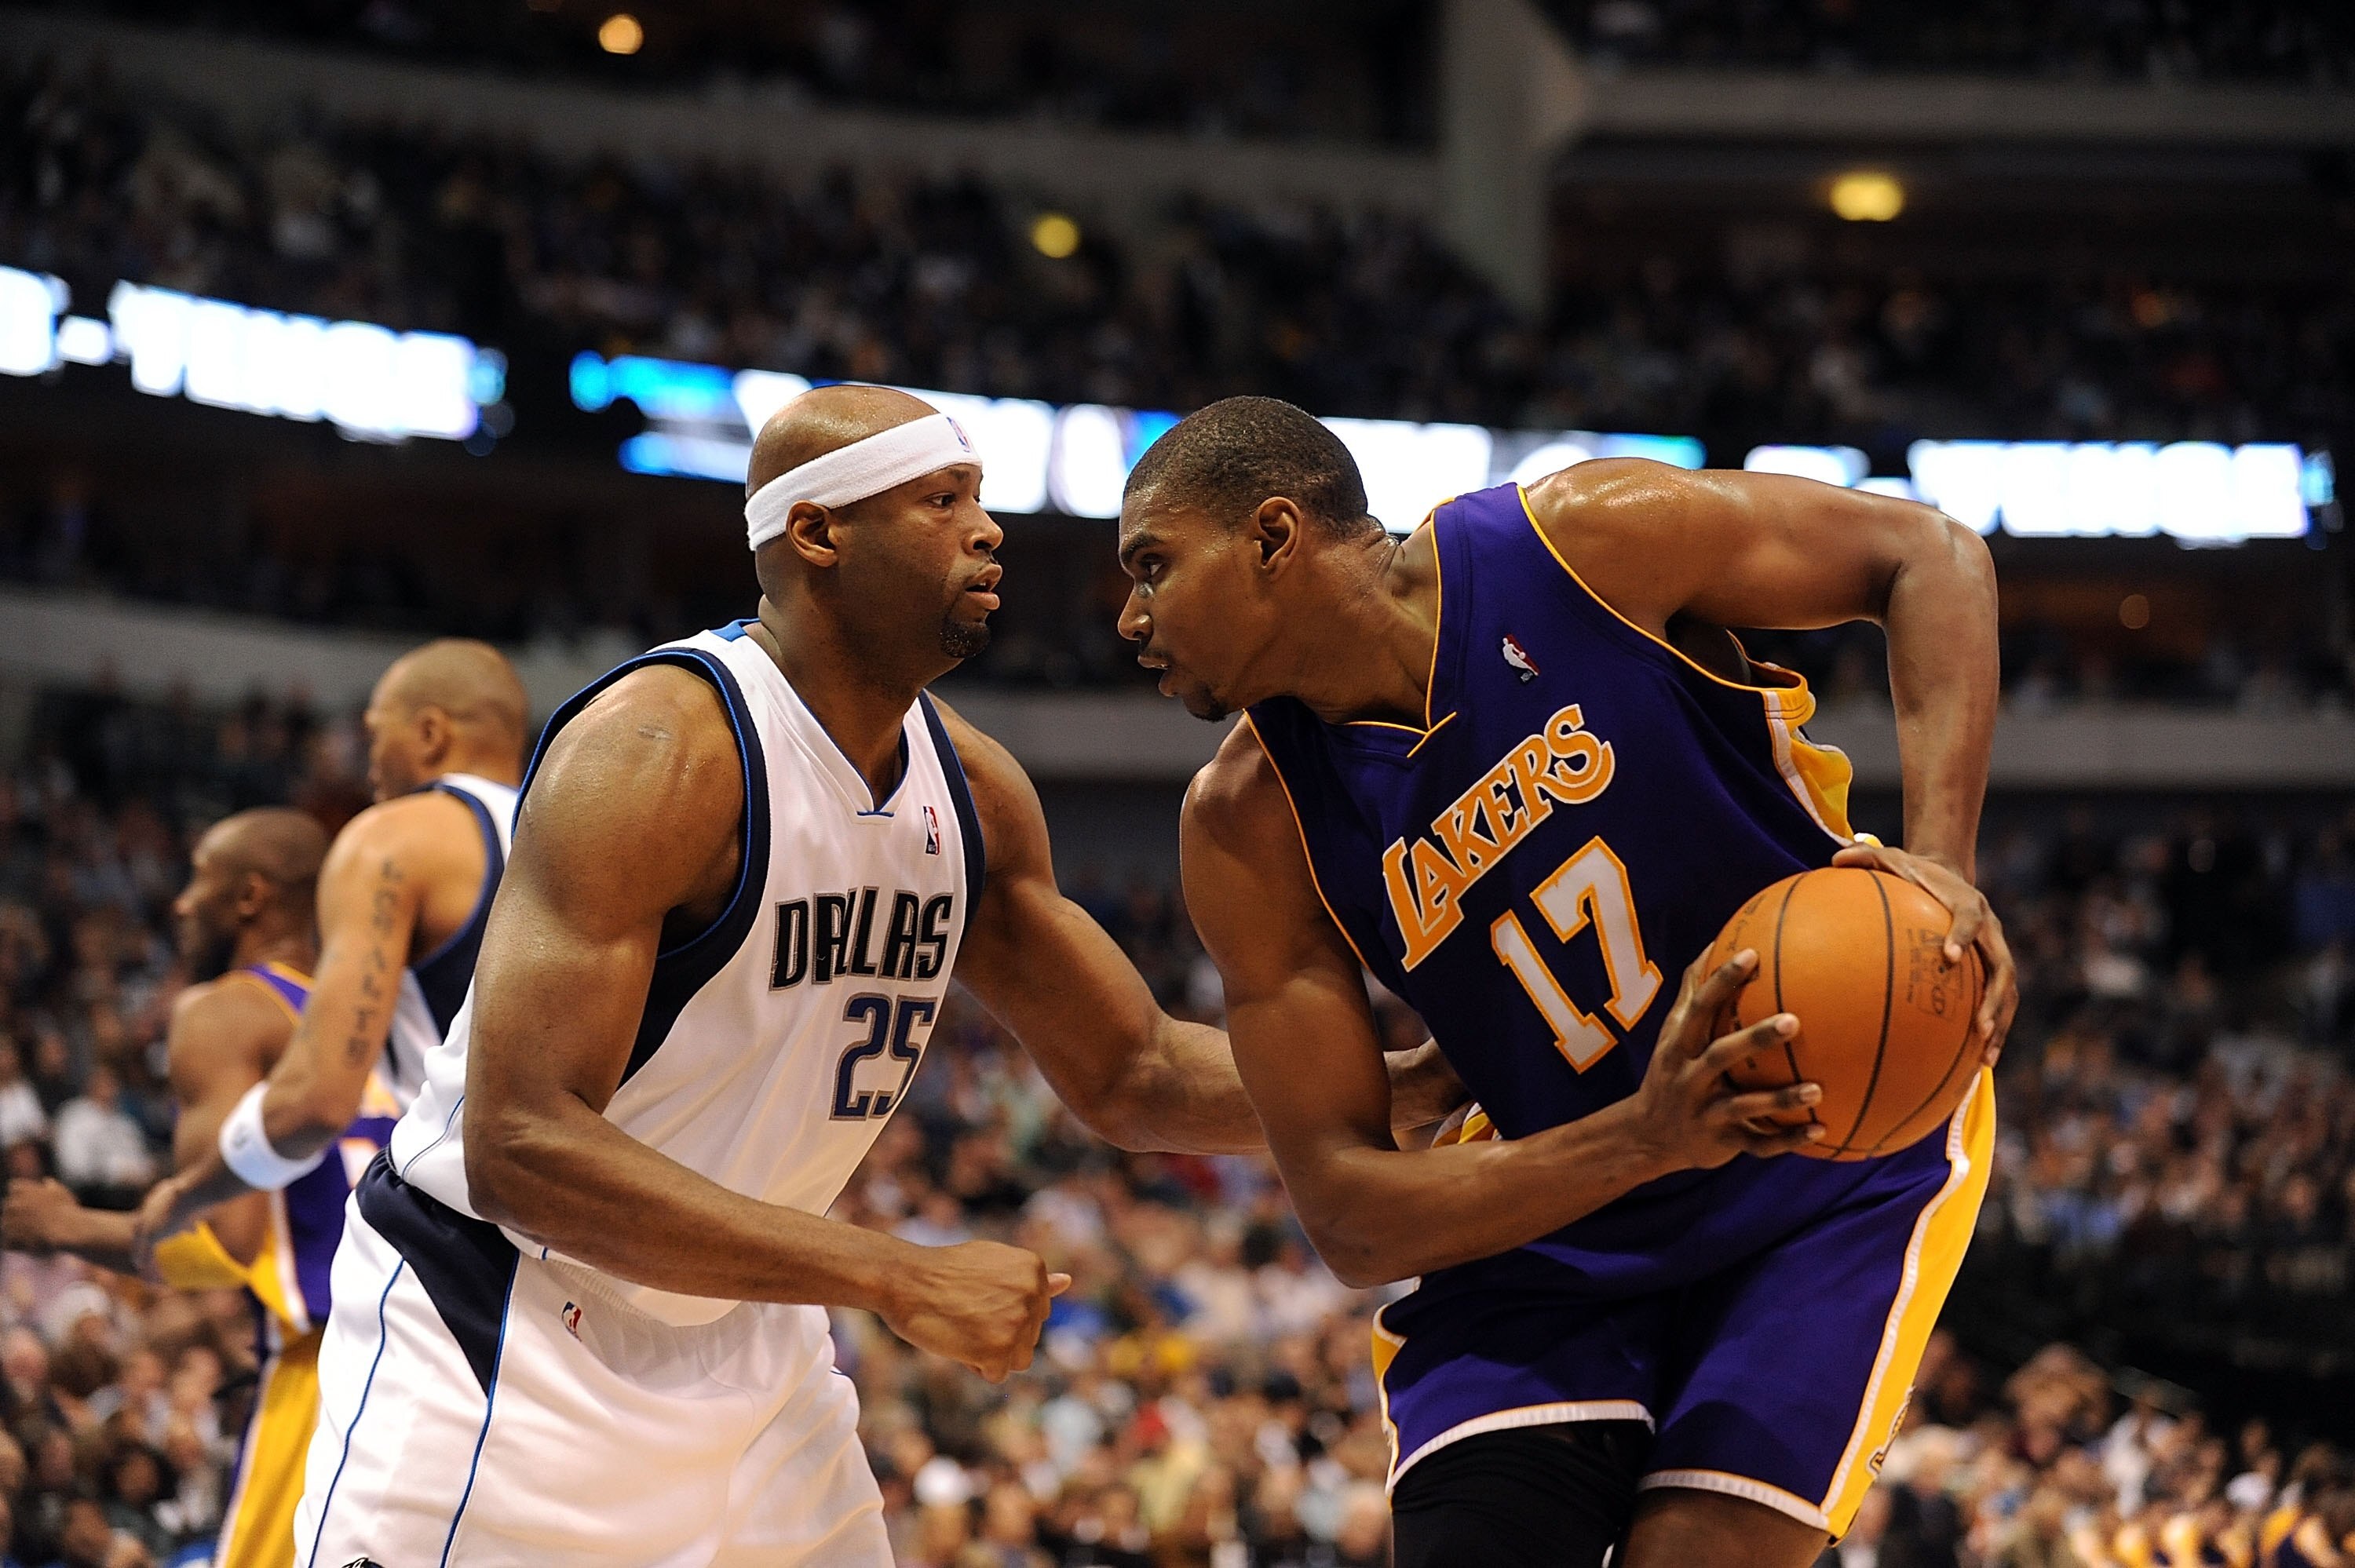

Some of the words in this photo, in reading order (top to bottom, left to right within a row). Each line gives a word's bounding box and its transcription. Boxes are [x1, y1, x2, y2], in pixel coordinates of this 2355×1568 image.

[1382, 703, 1616, 973] LAKERS
[1491, 835, 1664, 1074] 17
[828, 992, 938, 1121] 25
